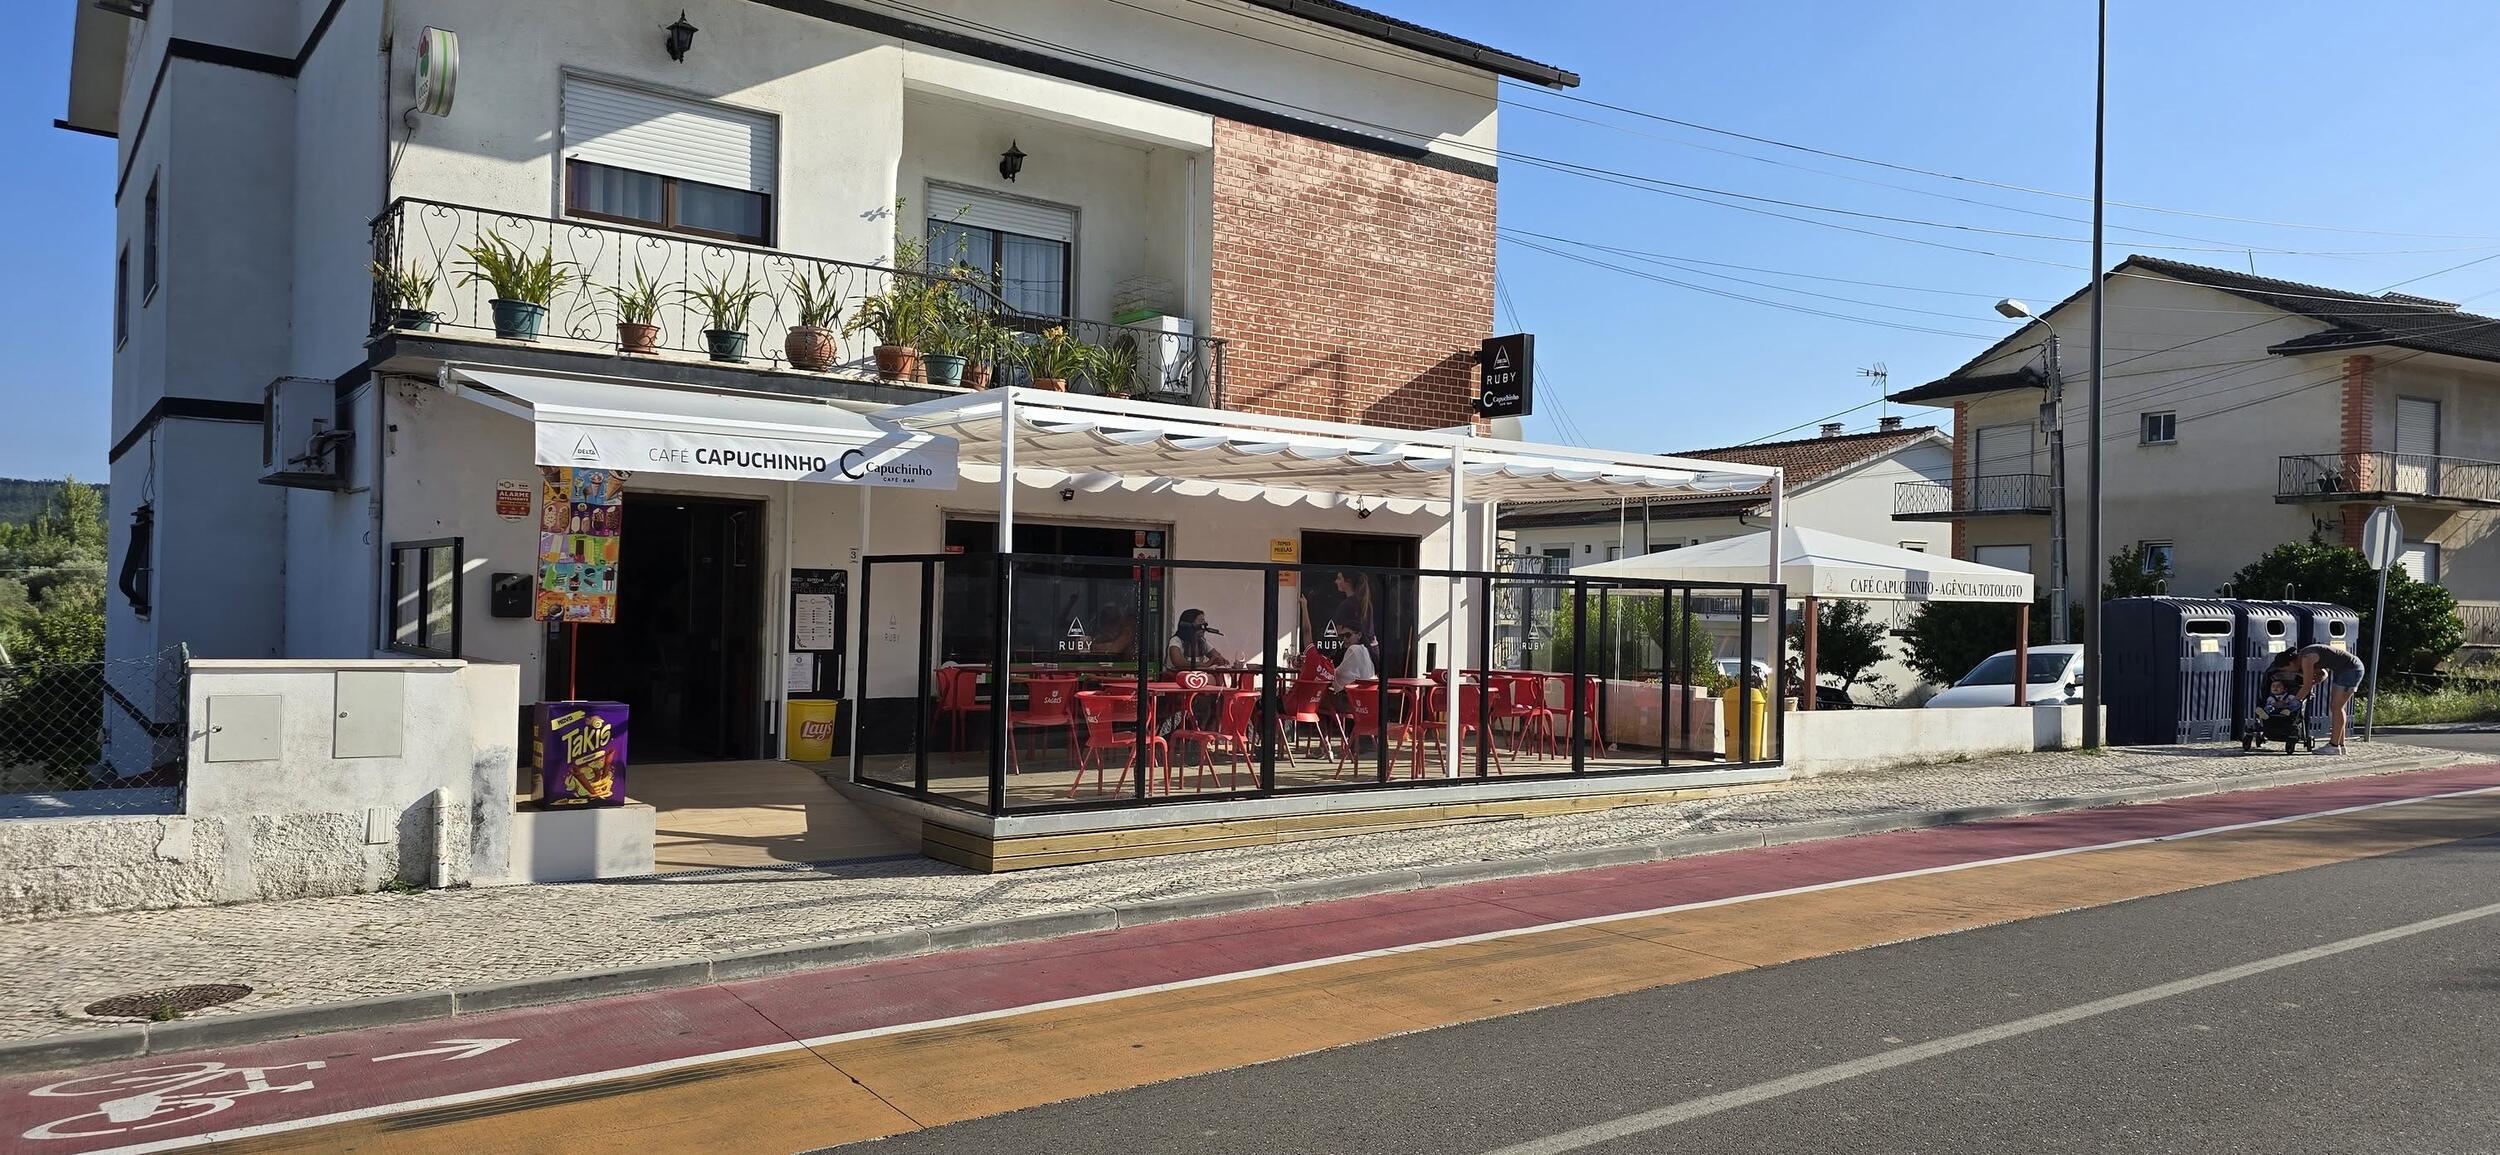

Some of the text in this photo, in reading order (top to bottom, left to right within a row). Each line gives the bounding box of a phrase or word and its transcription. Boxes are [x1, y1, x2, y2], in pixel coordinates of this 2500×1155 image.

[1486, 371, 1517, 385] RUBY
[1492, 393, 1520, 404] Capuchinho
[649, 447, 827, 473] CAFÉ CAPUCHINHO
[866, 461, 933, 477] Capuchinho
[499, 490, 530, 498] ALARME
[850, 551, 857, 559] 3
[1850, 576, 1875, 594] CAFÉ
[1876, 580, 1934, 596] CAPUCHINHO
[1939, 579, 1977, 597] AGÊNCIA
[1978, 583, 2023, 598] TOTOLOTO
[1059, 640, 1093, 651] RUBY
[1317, 640, 1345, 650] RUBY
[1522, 642, 1545, 651] RUBY
[557, 715, 573, 725] NOVO
[802, 719, 834, 741] Lay's
[562, 724, 612, 764] Takis
